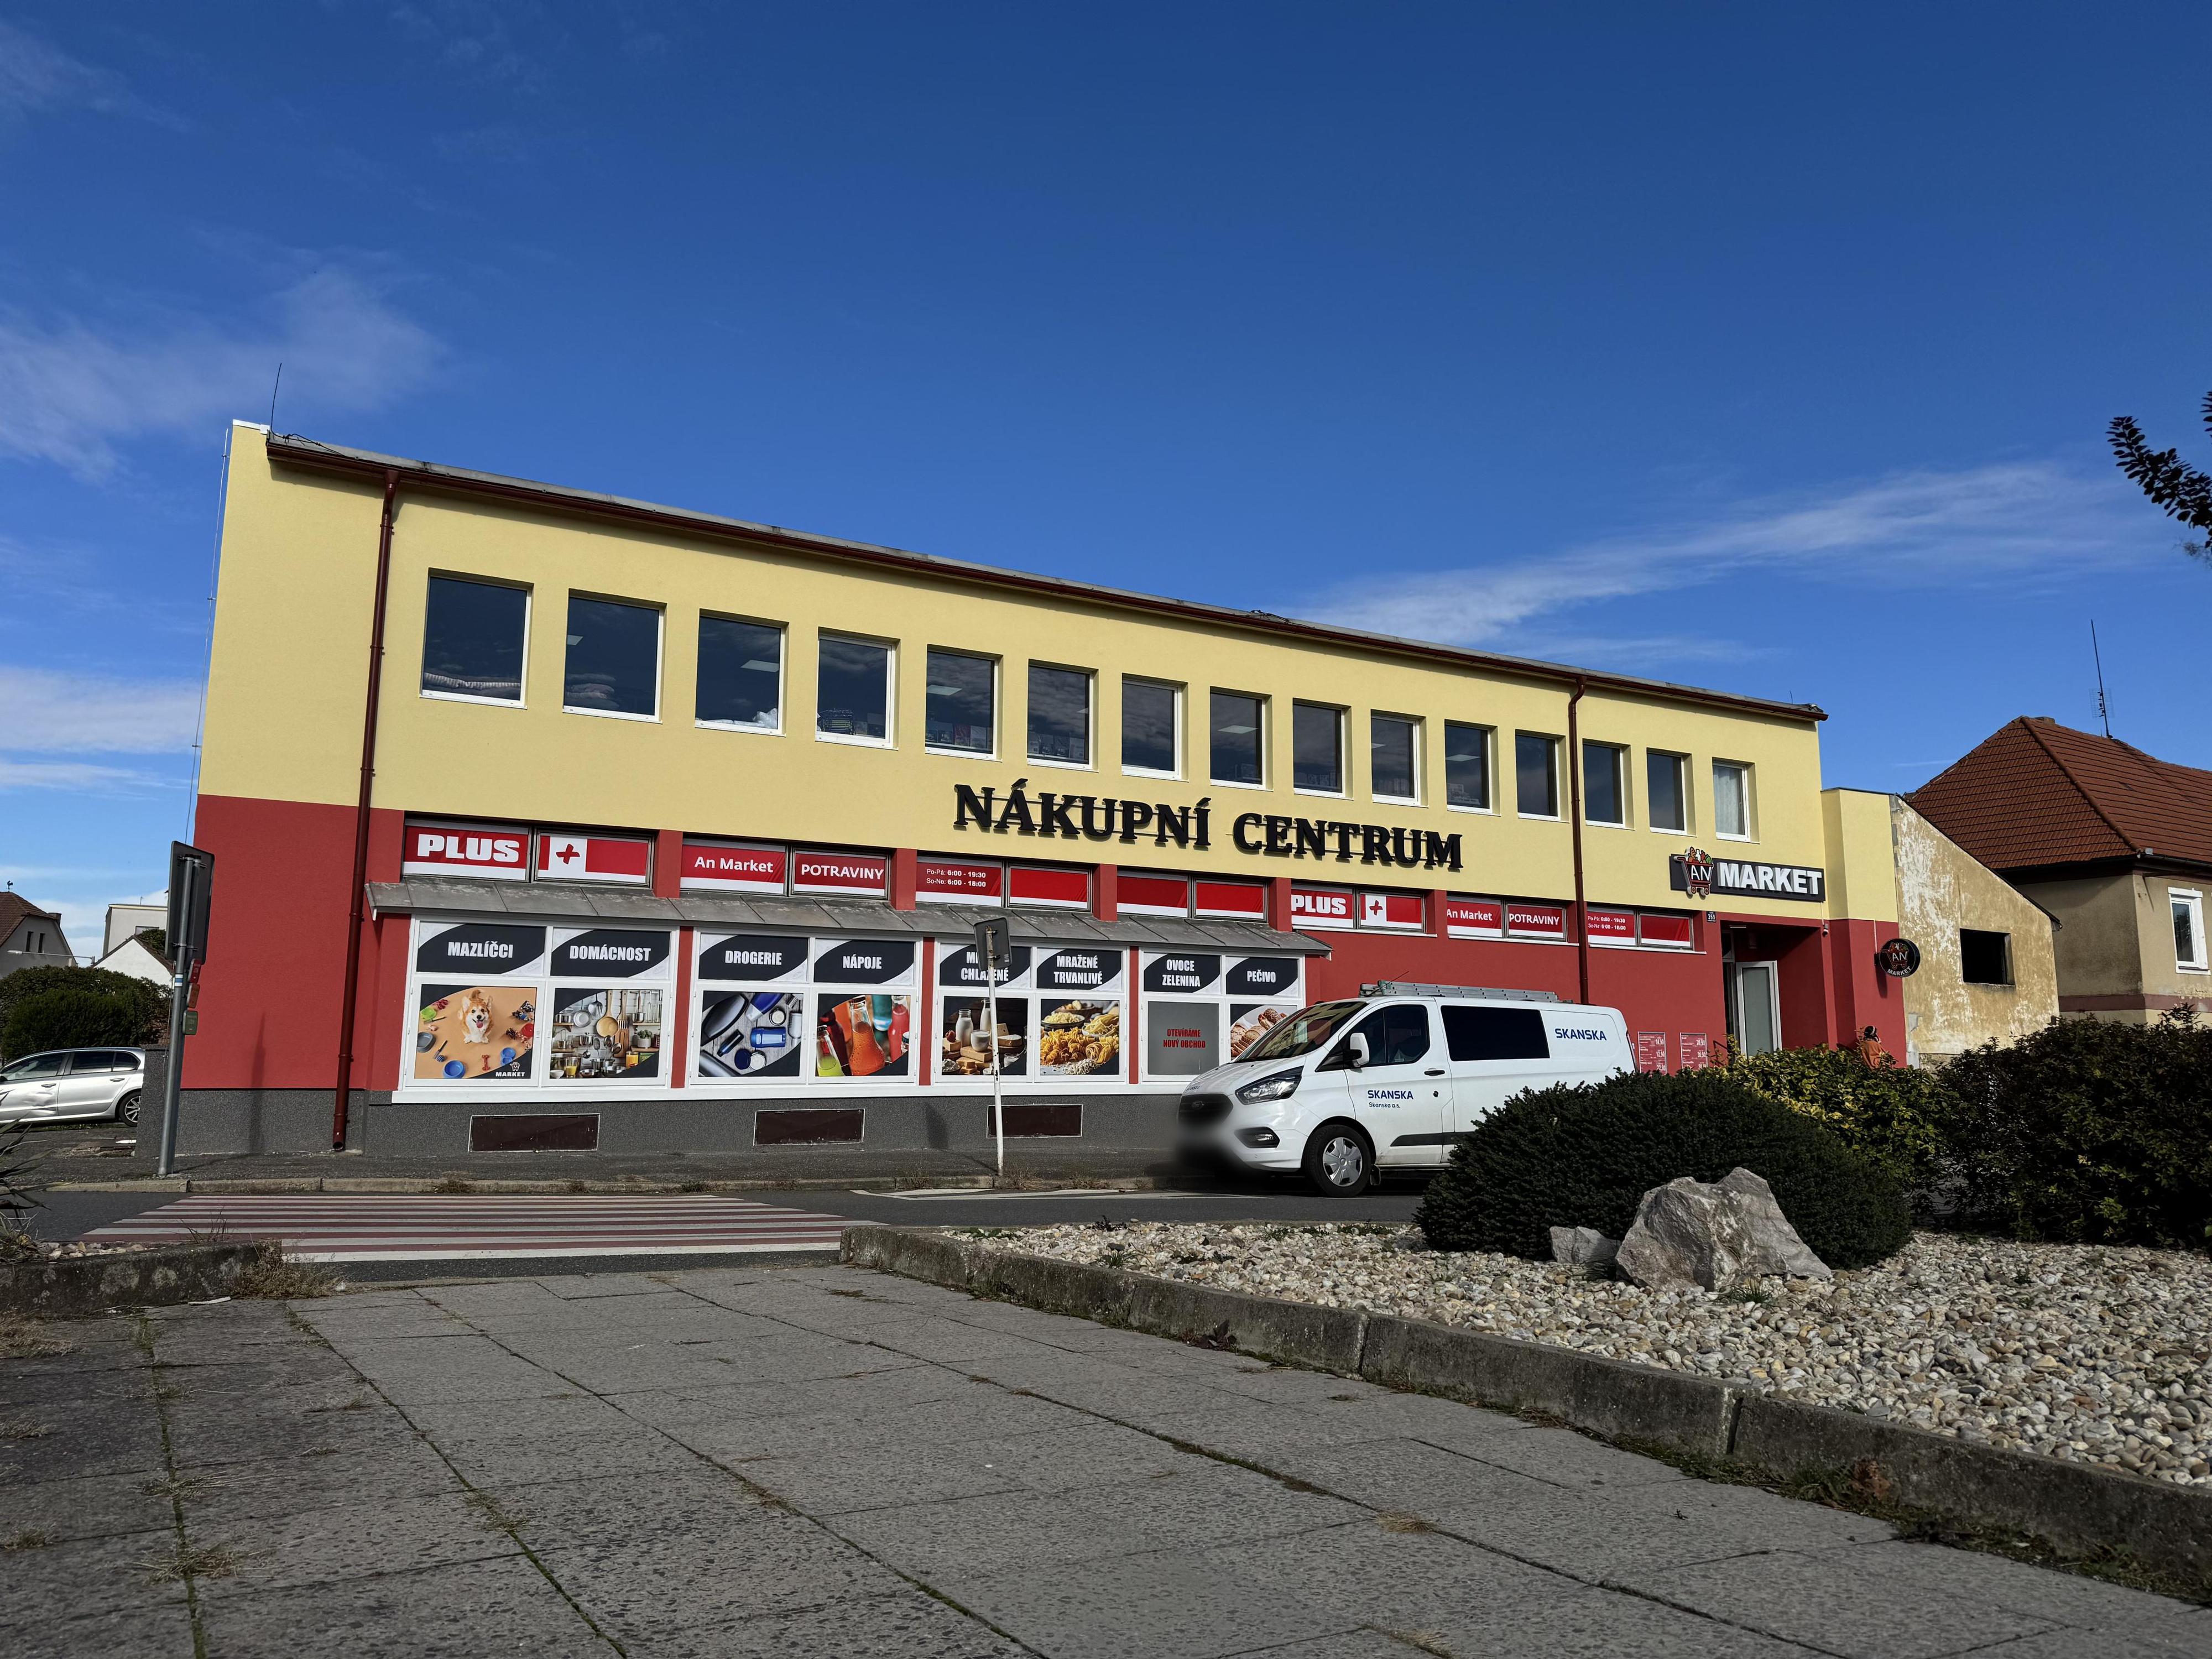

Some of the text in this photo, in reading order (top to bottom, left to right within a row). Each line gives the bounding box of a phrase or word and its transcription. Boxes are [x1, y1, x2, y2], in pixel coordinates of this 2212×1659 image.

[953, 778, 1463, 869] NÁKUPNÍ CENTRUM
[418, 833, 520, 863] PLUS
[694, 855, 774, 873] An Market
[801, 864, 884, 880] POTRAVINY
[1691, 862, 1822, 895] AN MARKET
[1291, 894, 1346, 915] PLUS
[1447, 909, 1493, 921] An Market
[1509, 913, 1559, 925] POTRAVINY
[447, 941, 514, 958] MAZLÍČCI
[569, 943, 651, 962] DOMÁCNOST
[1892, 951, 1907, 961] AN
[724, 950, 782, 966] DROGERIE
[842, 953, 882, 969] NÁPOJE
[1056, 954, 1098, 968] MRAŽENÉ
[1166, 959, 1194, 972] OVOCE
[1887, 966, 1912, 976] MARKET
[961, 967, 1009, 982] CHLAENÉ
[1053, 971, 1103, 984] TRVANLIVÉ
[1162, 974, 1201, 987] ZELENINA
[1247, 969, 1276, 983] PEČIVO
[1167, 1027, 1201, 1037] OTEVÍRÁME
[1554, 1028, 1607, 1041] SKANSKA
[1163, 1039, 1206, 1048] NOVÝ OBCHOD
[1368, 1090, 1414, 1099] SKANSKA
